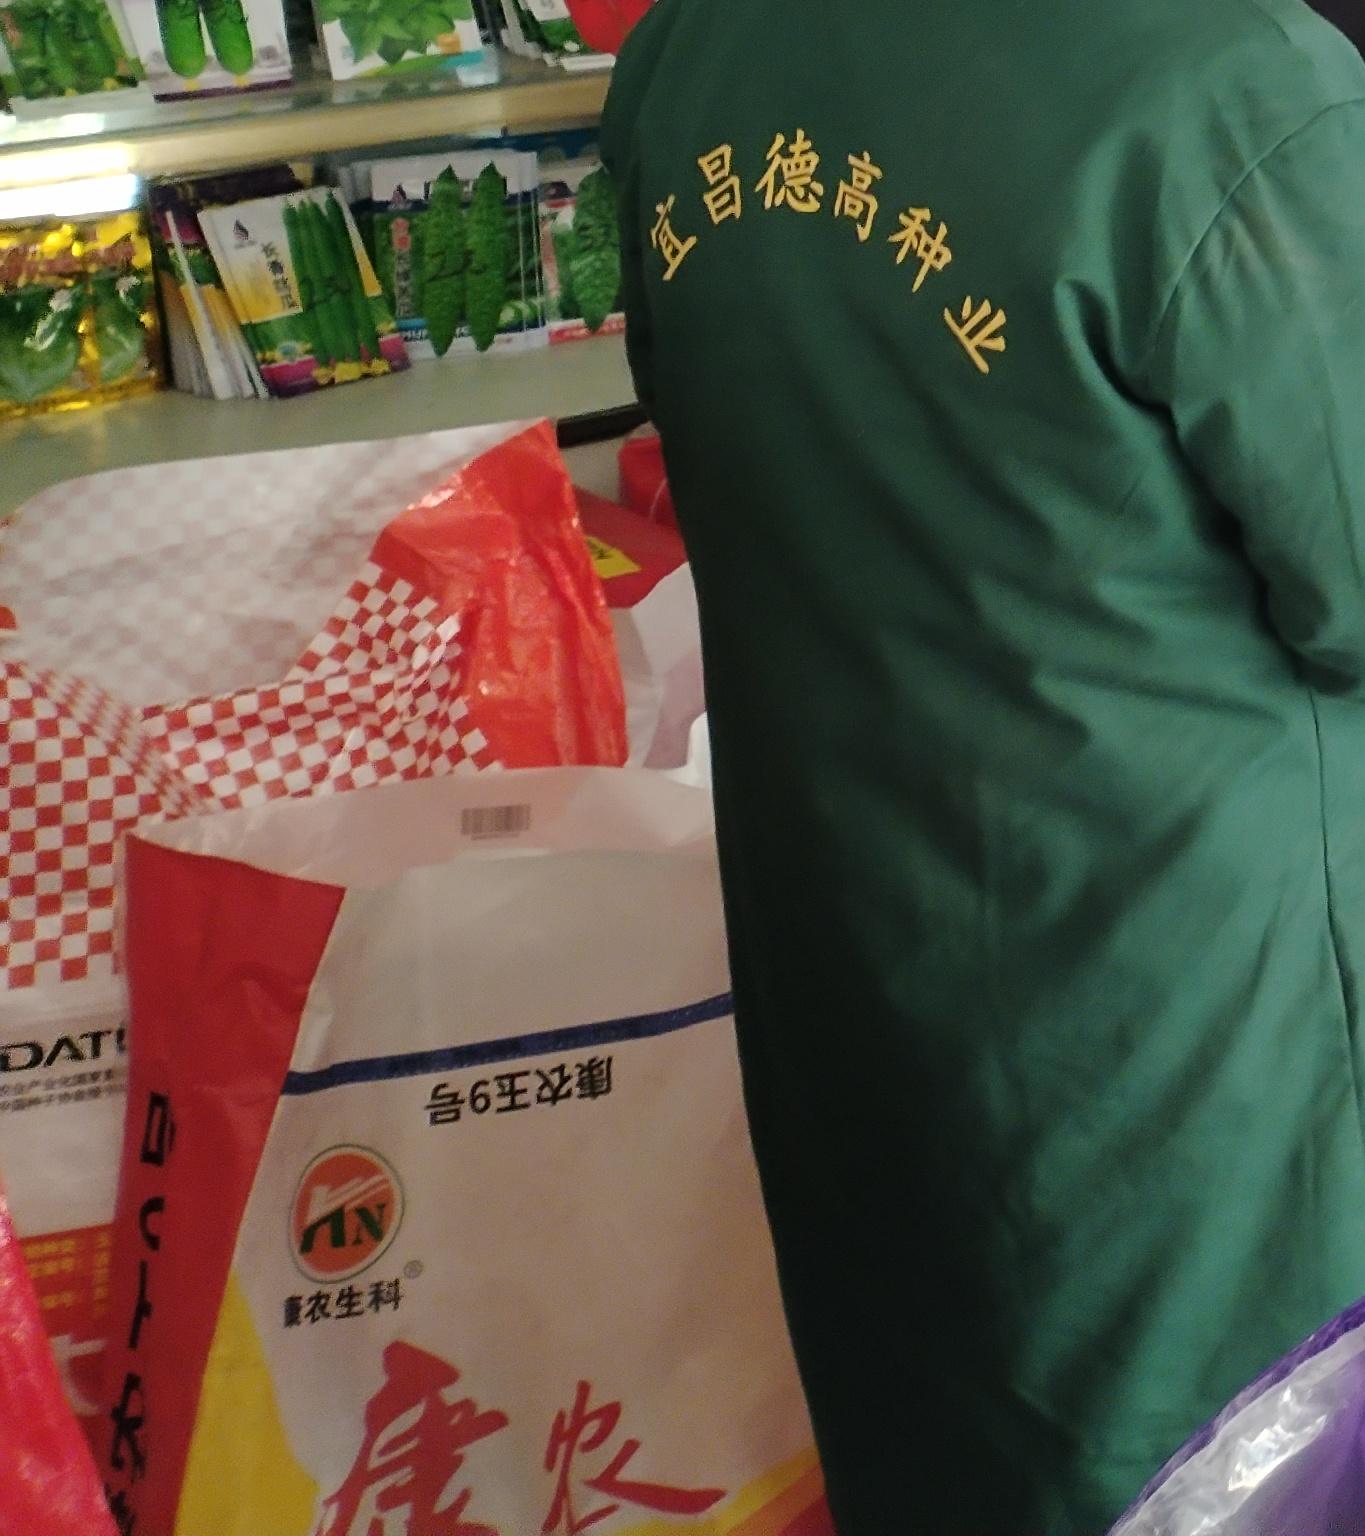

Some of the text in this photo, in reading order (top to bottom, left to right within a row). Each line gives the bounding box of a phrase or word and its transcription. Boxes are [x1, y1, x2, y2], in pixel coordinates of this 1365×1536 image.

[650, 127, 1007, 375] 宜昌德高种业
[423, 1055, 614, 1127] 康农玉9号
